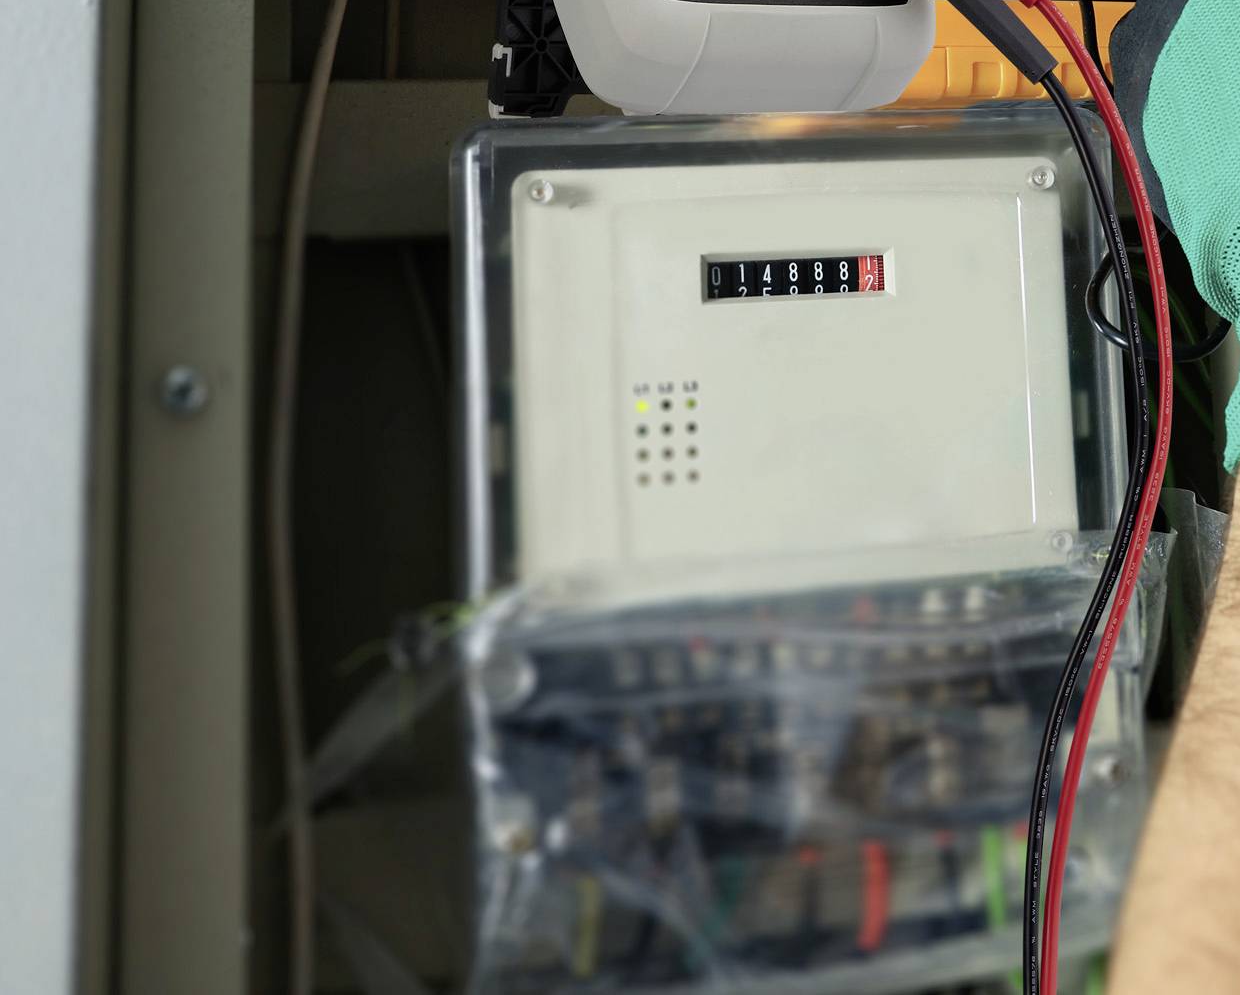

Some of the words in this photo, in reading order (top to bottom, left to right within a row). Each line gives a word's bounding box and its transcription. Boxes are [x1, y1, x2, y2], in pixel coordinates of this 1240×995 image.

[1095, 571, 1117, 620] SILICONE
[1118, 514, 1134, 559] RUBBER
[1136, 513, 1149, 550] STYLE
